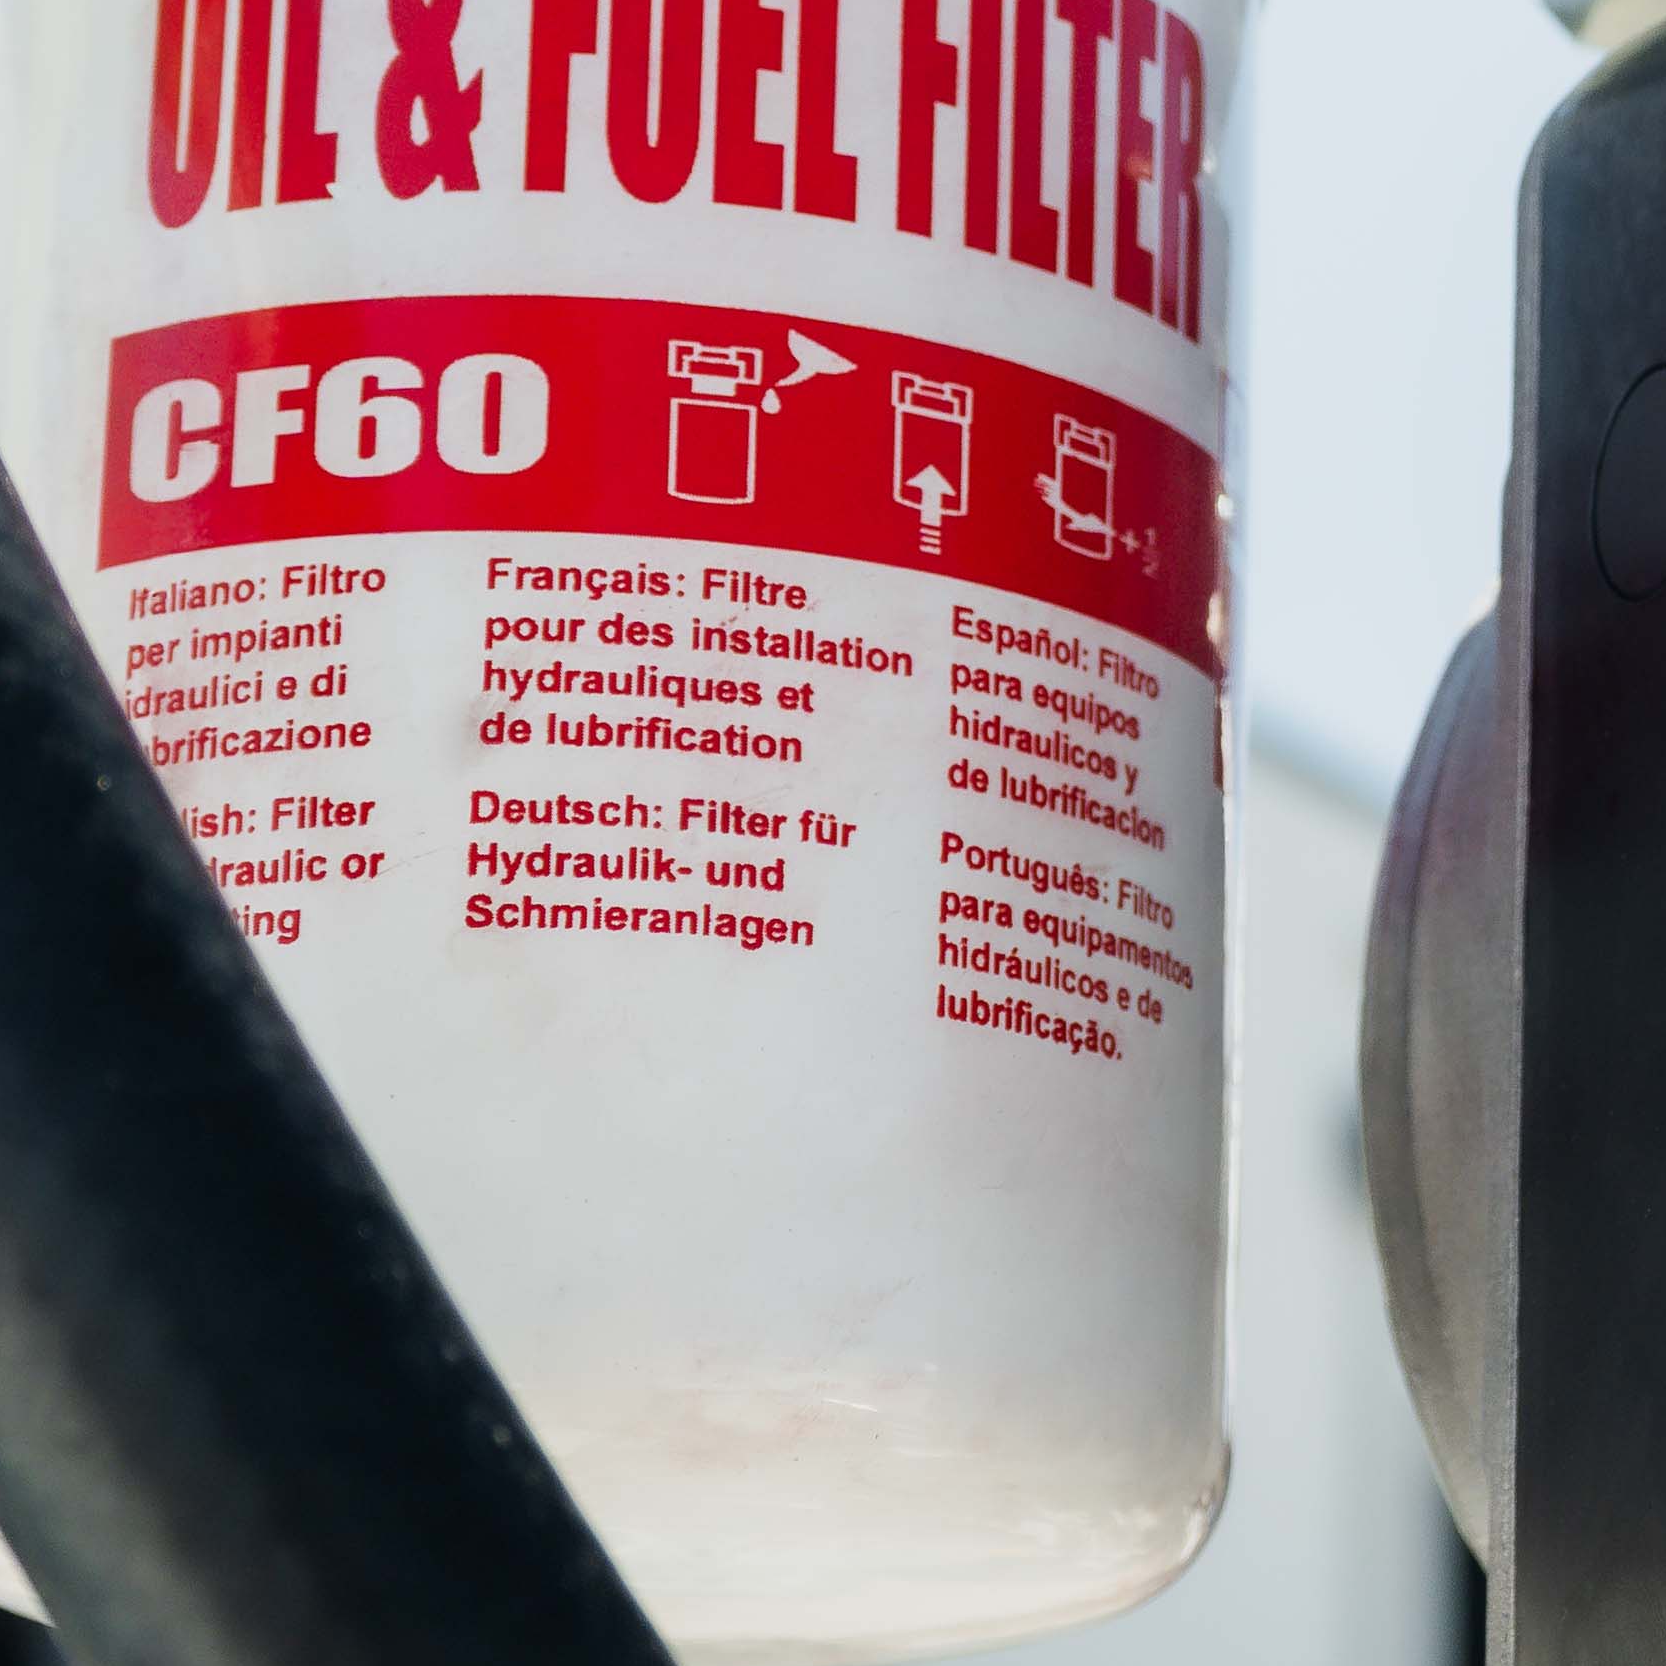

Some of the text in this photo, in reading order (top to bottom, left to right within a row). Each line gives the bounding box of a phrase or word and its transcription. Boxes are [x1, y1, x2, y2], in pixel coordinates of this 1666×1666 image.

[131, 353, 550, 503] CF60
[128, 563, 387, 620] Italiano: Filtro
[487, 557, 808, 610] Français: Filtre
[126, 613, 342, 680] per impianti
[484, 612, 914, 677] pour des installation
[951, 604, 1161, 701] Español: Filtro
[125, 665, 349, 721] idraulici e di
[482, 660, 815, 713] hydrauliques et
[950, 660, 1141, 741] para equipos
[145, 720, 372, 766] brificazione
[479, 712, 803, 763] de lubrification
[949, 704, 1139, 796] hidraulicos y
[948, 758, 989, 794] de
[271, 795, 375, 832] Filter
[469, 790, 857, 848] Deutsch: Filter für
[341, 849, 385, 879] or
[467, 841, 785, 892] Hydraulik- und
[940, 830, 1175, 931] Português: Filtro
[464, 893, 815, 951] Schmieranlagen
[939, 889, 1194, 991] para equipamentos
[937, 933, 1164, 1025] hidráulicos e de
[936, 984, 1123, 1061] lubrificação.
